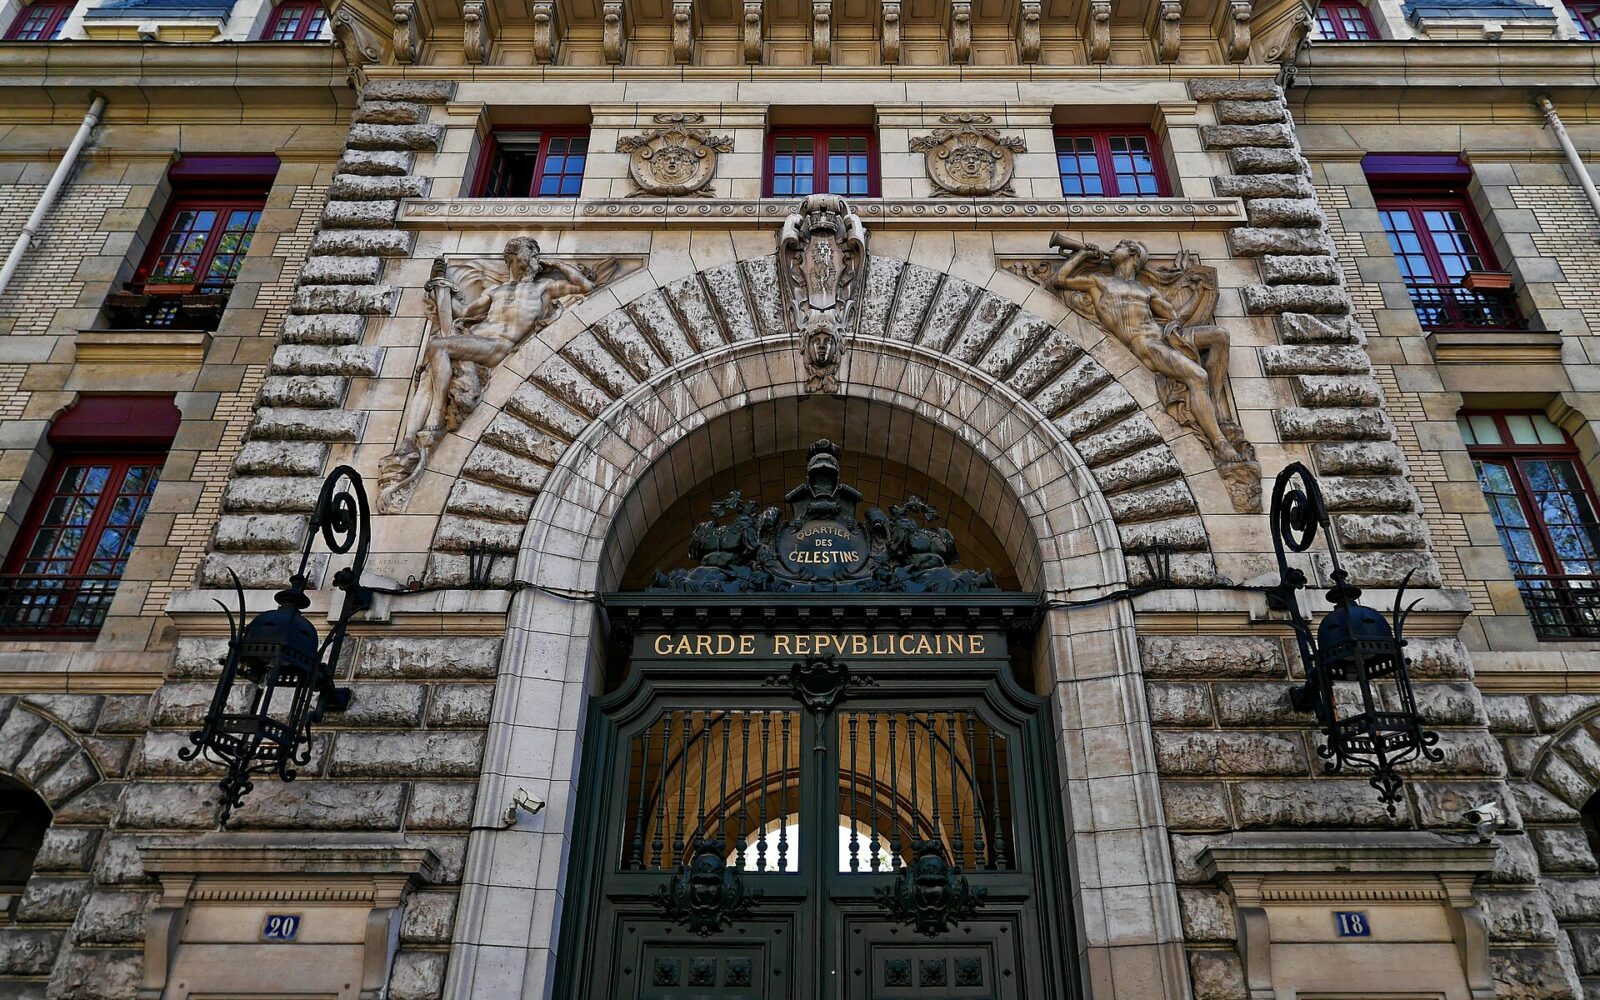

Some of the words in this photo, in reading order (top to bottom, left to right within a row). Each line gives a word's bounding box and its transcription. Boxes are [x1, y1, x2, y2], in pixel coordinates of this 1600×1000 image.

[796, 526, 851, 540] QUARTIER
[815, 539, 833, 547] DES
[788, 550, 860, 564] CELESTINS
[654, 634, 756, 655] GARDE
[772, 634, 985, 655] REPVBLICAINE
[267, 917, 294, 936] 20
[1340, 914, 1364, 934] 18
